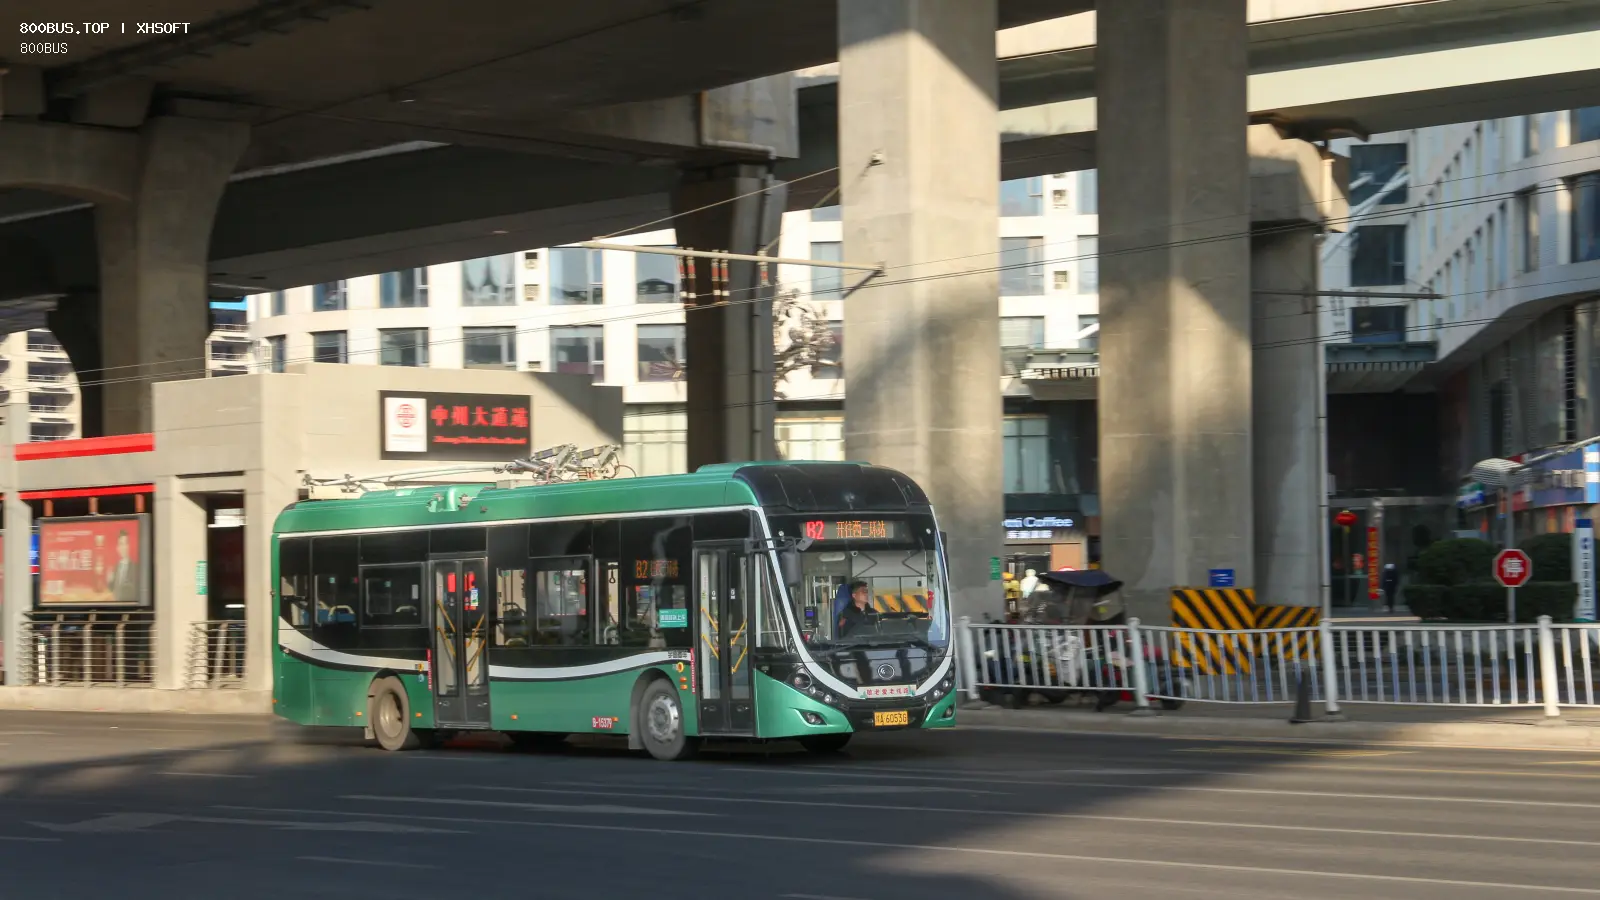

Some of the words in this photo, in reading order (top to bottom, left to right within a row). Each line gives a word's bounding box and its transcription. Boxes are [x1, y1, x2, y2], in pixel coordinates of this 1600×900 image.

[430, 404, 529, 428] 中州大道站
[806, 521, 825, 540] B2
[836, 520, 886, 539] 开往西三环站
[1024, 516, 1074, 528] Coffee
[635, 559, 649, 579] B2
[1501, 557, 1524, 578] 停
